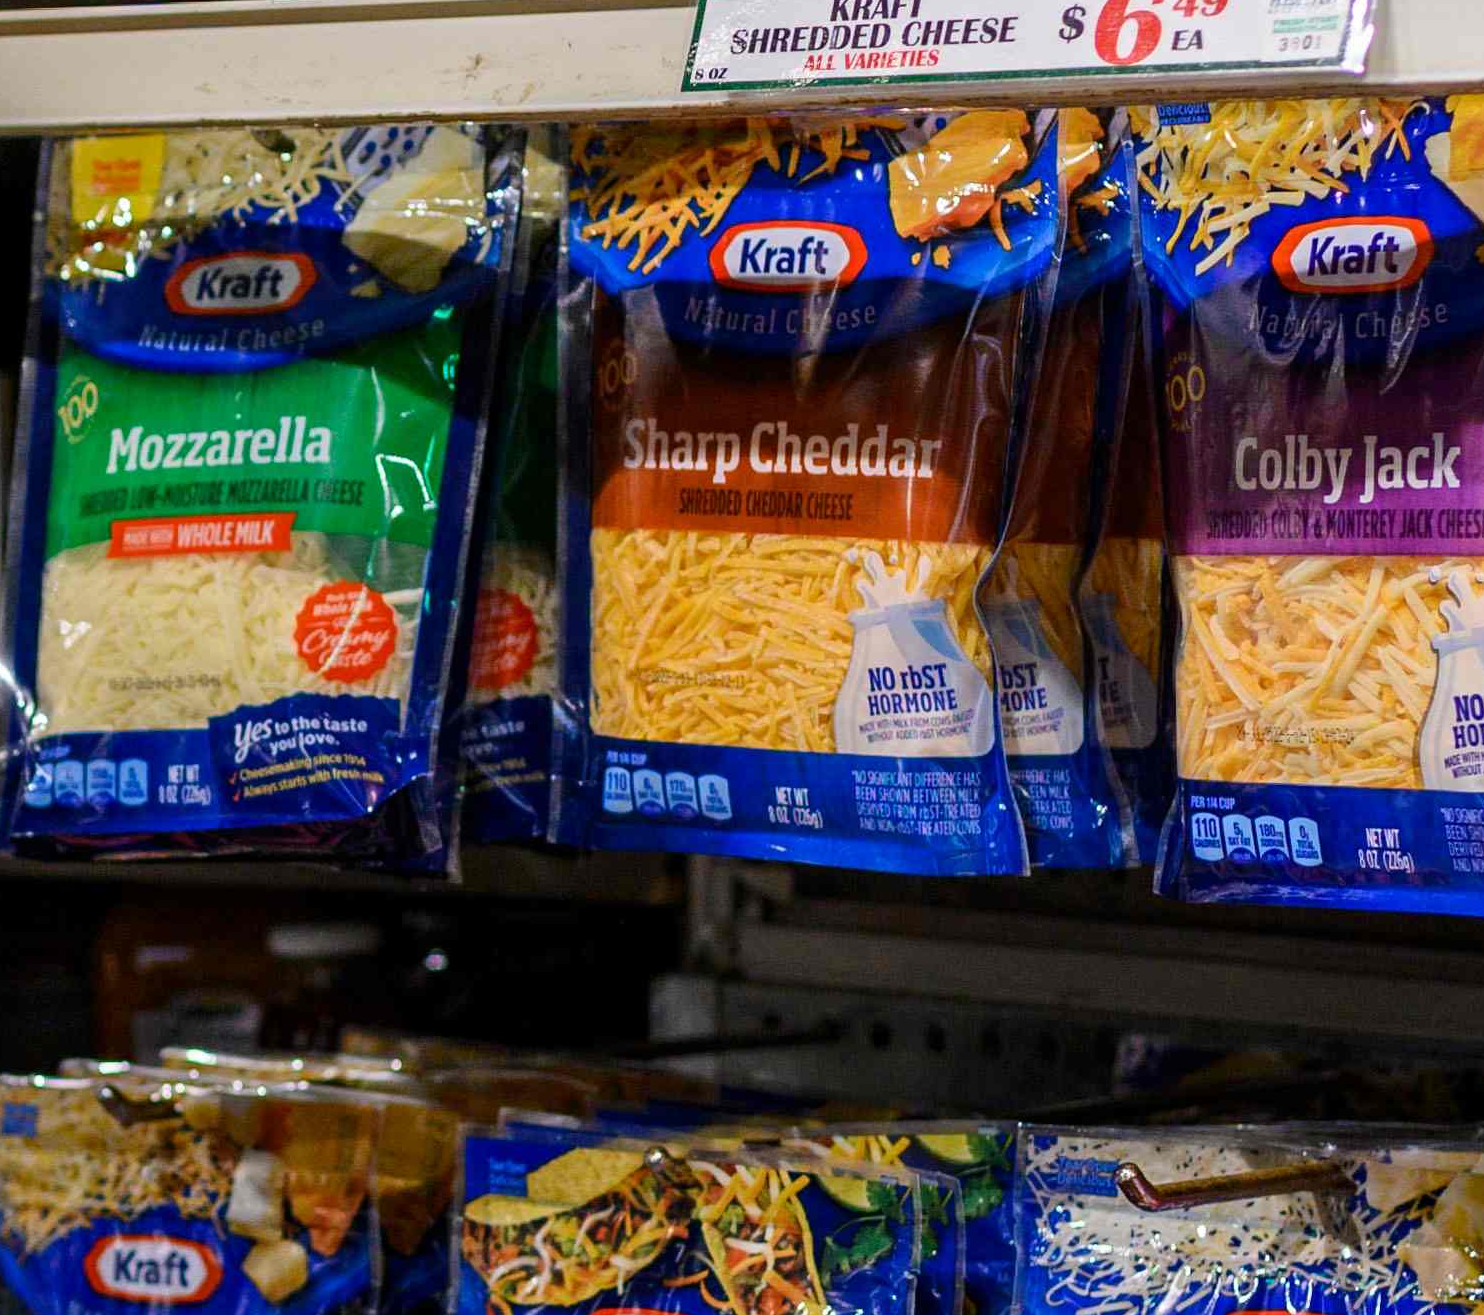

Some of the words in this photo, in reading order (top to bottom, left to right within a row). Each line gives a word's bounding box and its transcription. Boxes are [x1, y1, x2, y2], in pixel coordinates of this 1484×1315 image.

[729, 24, 893, 57] SHREDDED
[901, 15, 1018, 47] CHEESE
[1058, 4, 1088, 44] $
[1171, 29, 1204, 52] EA
[708, 66, 728, 81] OZ
[802, 51, 839, 71] ALL
[844, 48, 941, 70] VARIETIES
[737, 235, 830, 277] Kraft
[1306, 233, 1401, 279] Kraft
[195, 265, 284, 302] Kraft
[138, 325, 228, 352] Natural
[236, 316, 328, 348] Cheese
[106, 415, 333, 475] Mozzarella
[623, 417, 742, 485] Sharp
[748, 421, 943, 480] Cheddar
[1234, 433, 1353, 504] Colby
[1359, 433, 1461, 504] Jack
[678, 488, 742, 518] SHREDDED
[745, 488, 804, 518] CHEDDAR
[806, 491, 854, 521] CHEESE
[177, 522, 232, 548] WHOLE
[235, 518, 274, 545] MILK
[1326, 508, 1396, 539] MONTEREY
[1399, 508, 1435, 539] JACK
[868, 666, 896, 692] NO
[900, 662, 948, 691] rbST
[867, 688, 959, 717] HORMONE
[1453, 694, 1484, 722] NO
[113, 1248, 191, 1288] Kraft
